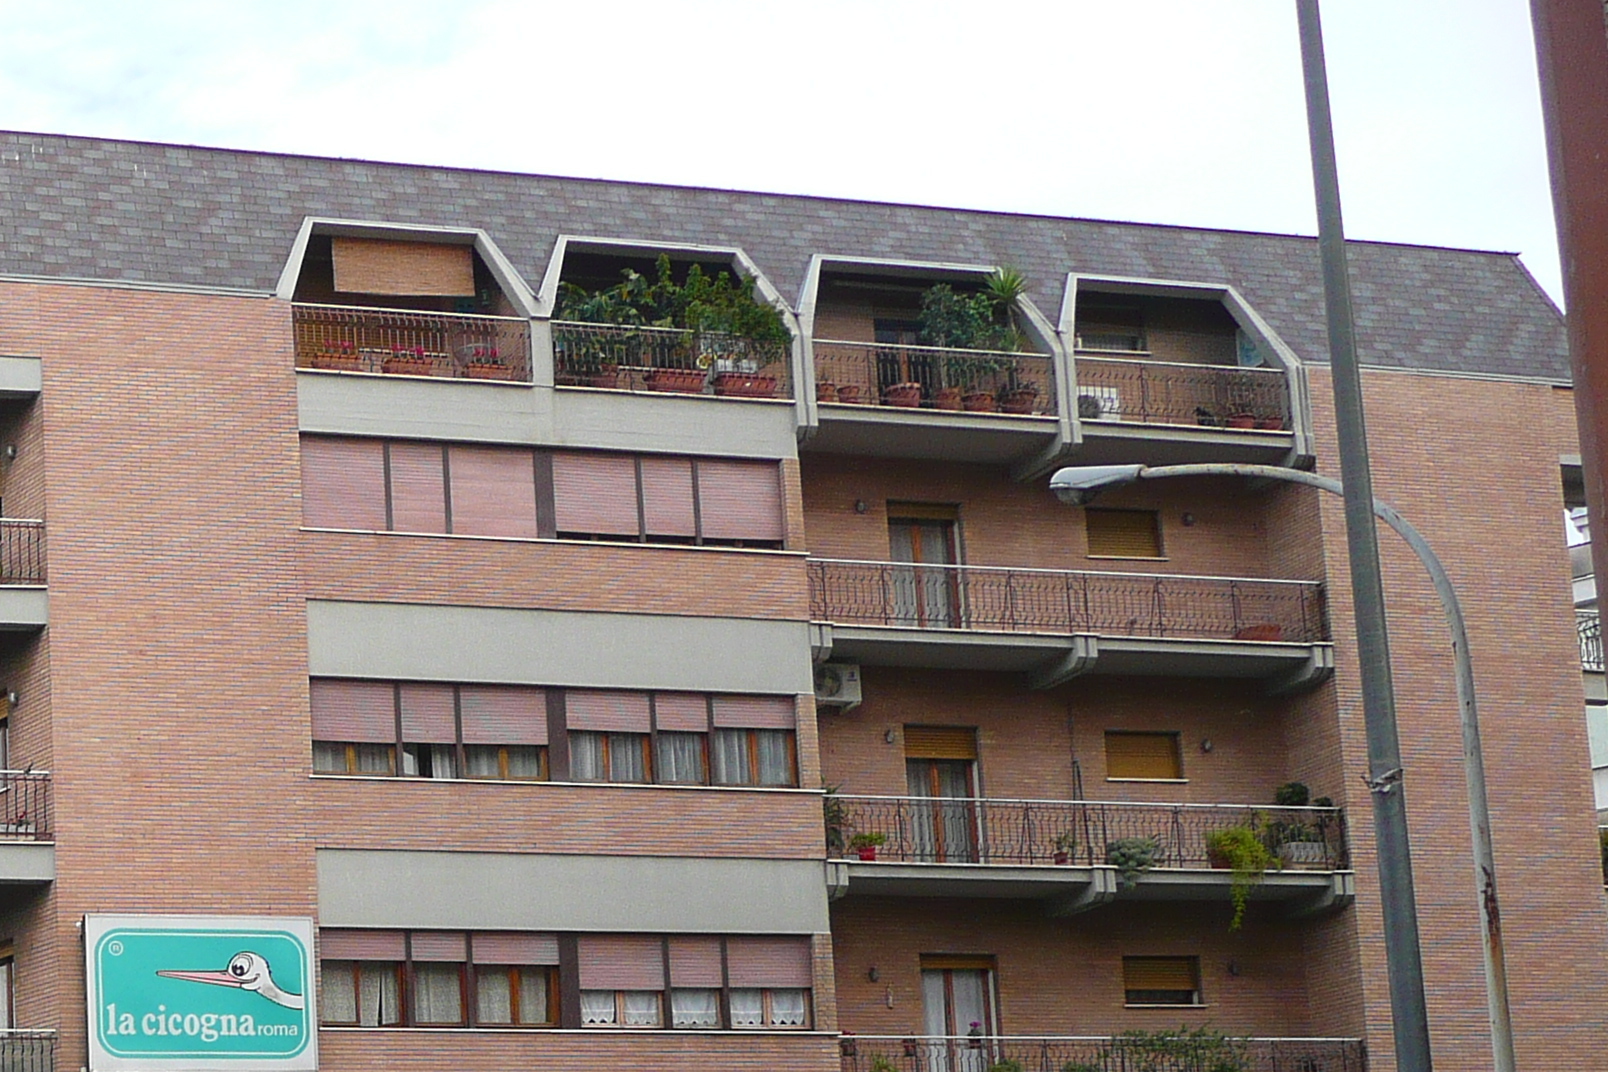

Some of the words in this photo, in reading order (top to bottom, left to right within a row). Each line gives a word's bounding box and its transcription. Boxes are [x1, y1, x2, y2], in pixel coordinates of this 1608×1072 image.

[106, 1003, 136, 1035] la
[142, 1004, 256, 1042] cicogna
[258, 1024, 298, 1036] roma
